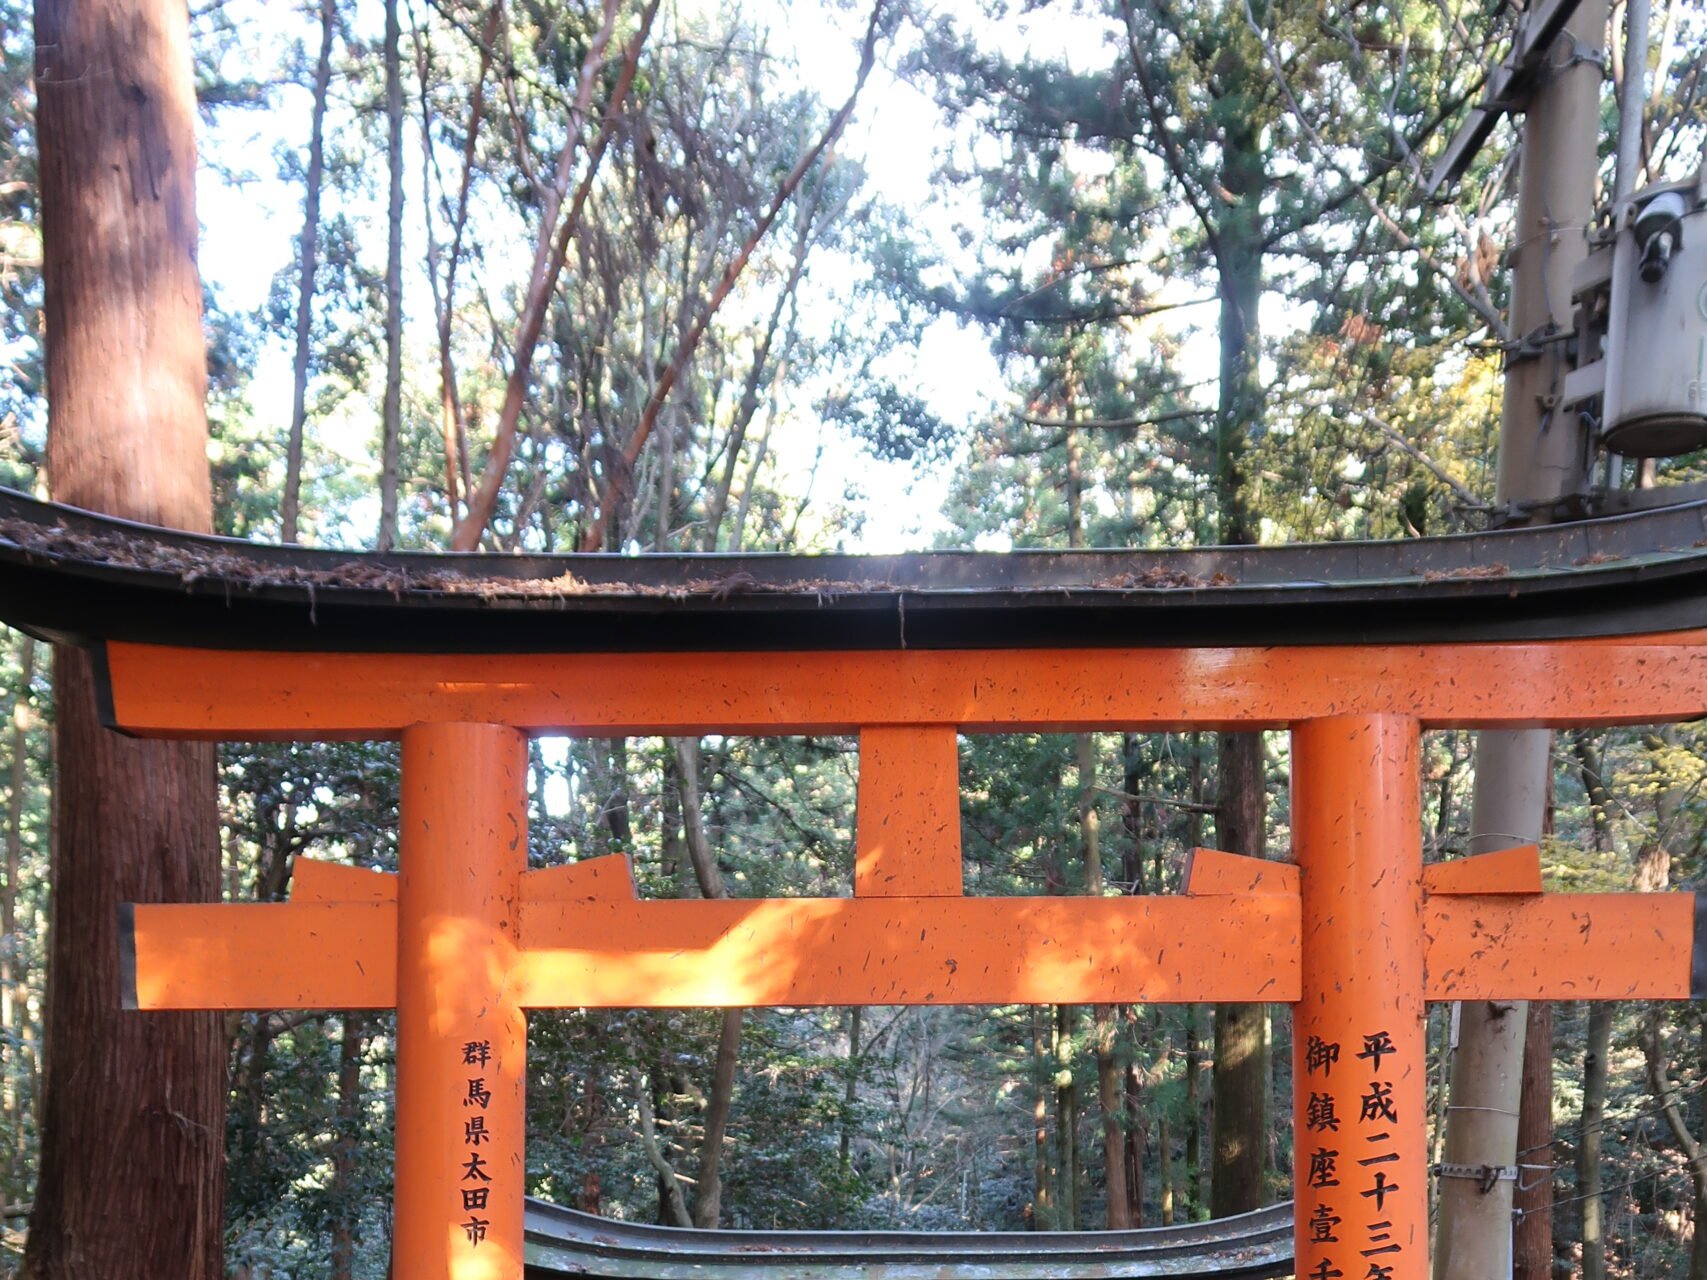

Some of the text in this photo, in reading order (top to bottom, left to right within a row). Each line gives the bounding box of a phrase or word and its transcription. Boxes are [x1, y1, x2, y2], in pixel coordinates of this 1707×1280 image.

[461, 1040, 492, 1248] 群馬県太田市
